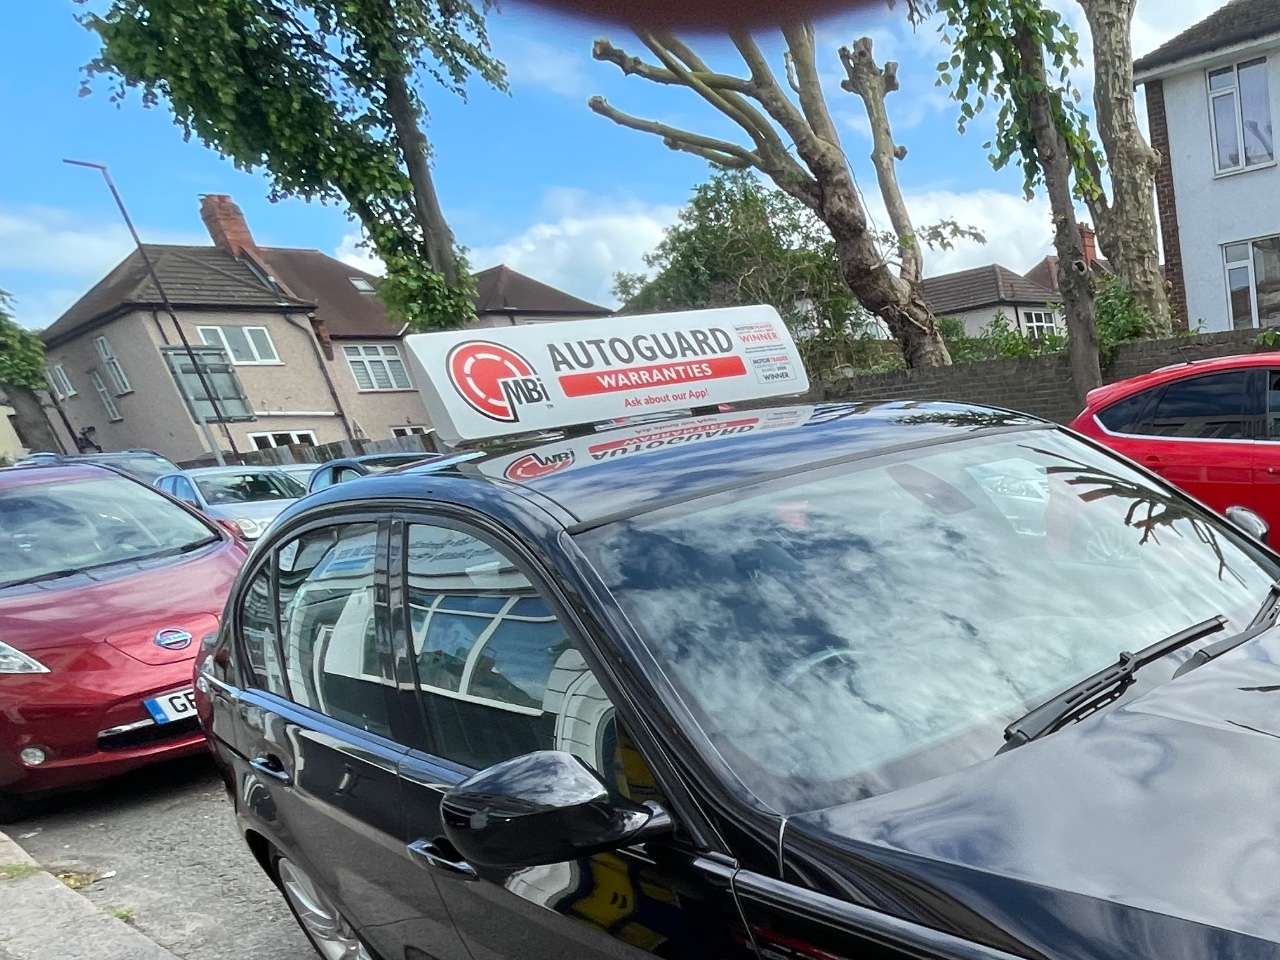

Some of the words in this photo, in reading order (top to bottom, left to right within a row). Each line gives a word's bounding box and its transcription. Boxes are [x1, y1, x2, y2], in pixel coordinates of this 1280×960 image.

[739, 331, 777, 343] WINNER
[547, 327, 734, 372] AUTOGUARD
[597, 363, 713, 389] WARRANTIES
[624, 397, 642, 408] Ask
[644, 393, 671, 406] about
[671, 392, 687, 401] our
[688, 387, 709, 399] App!
